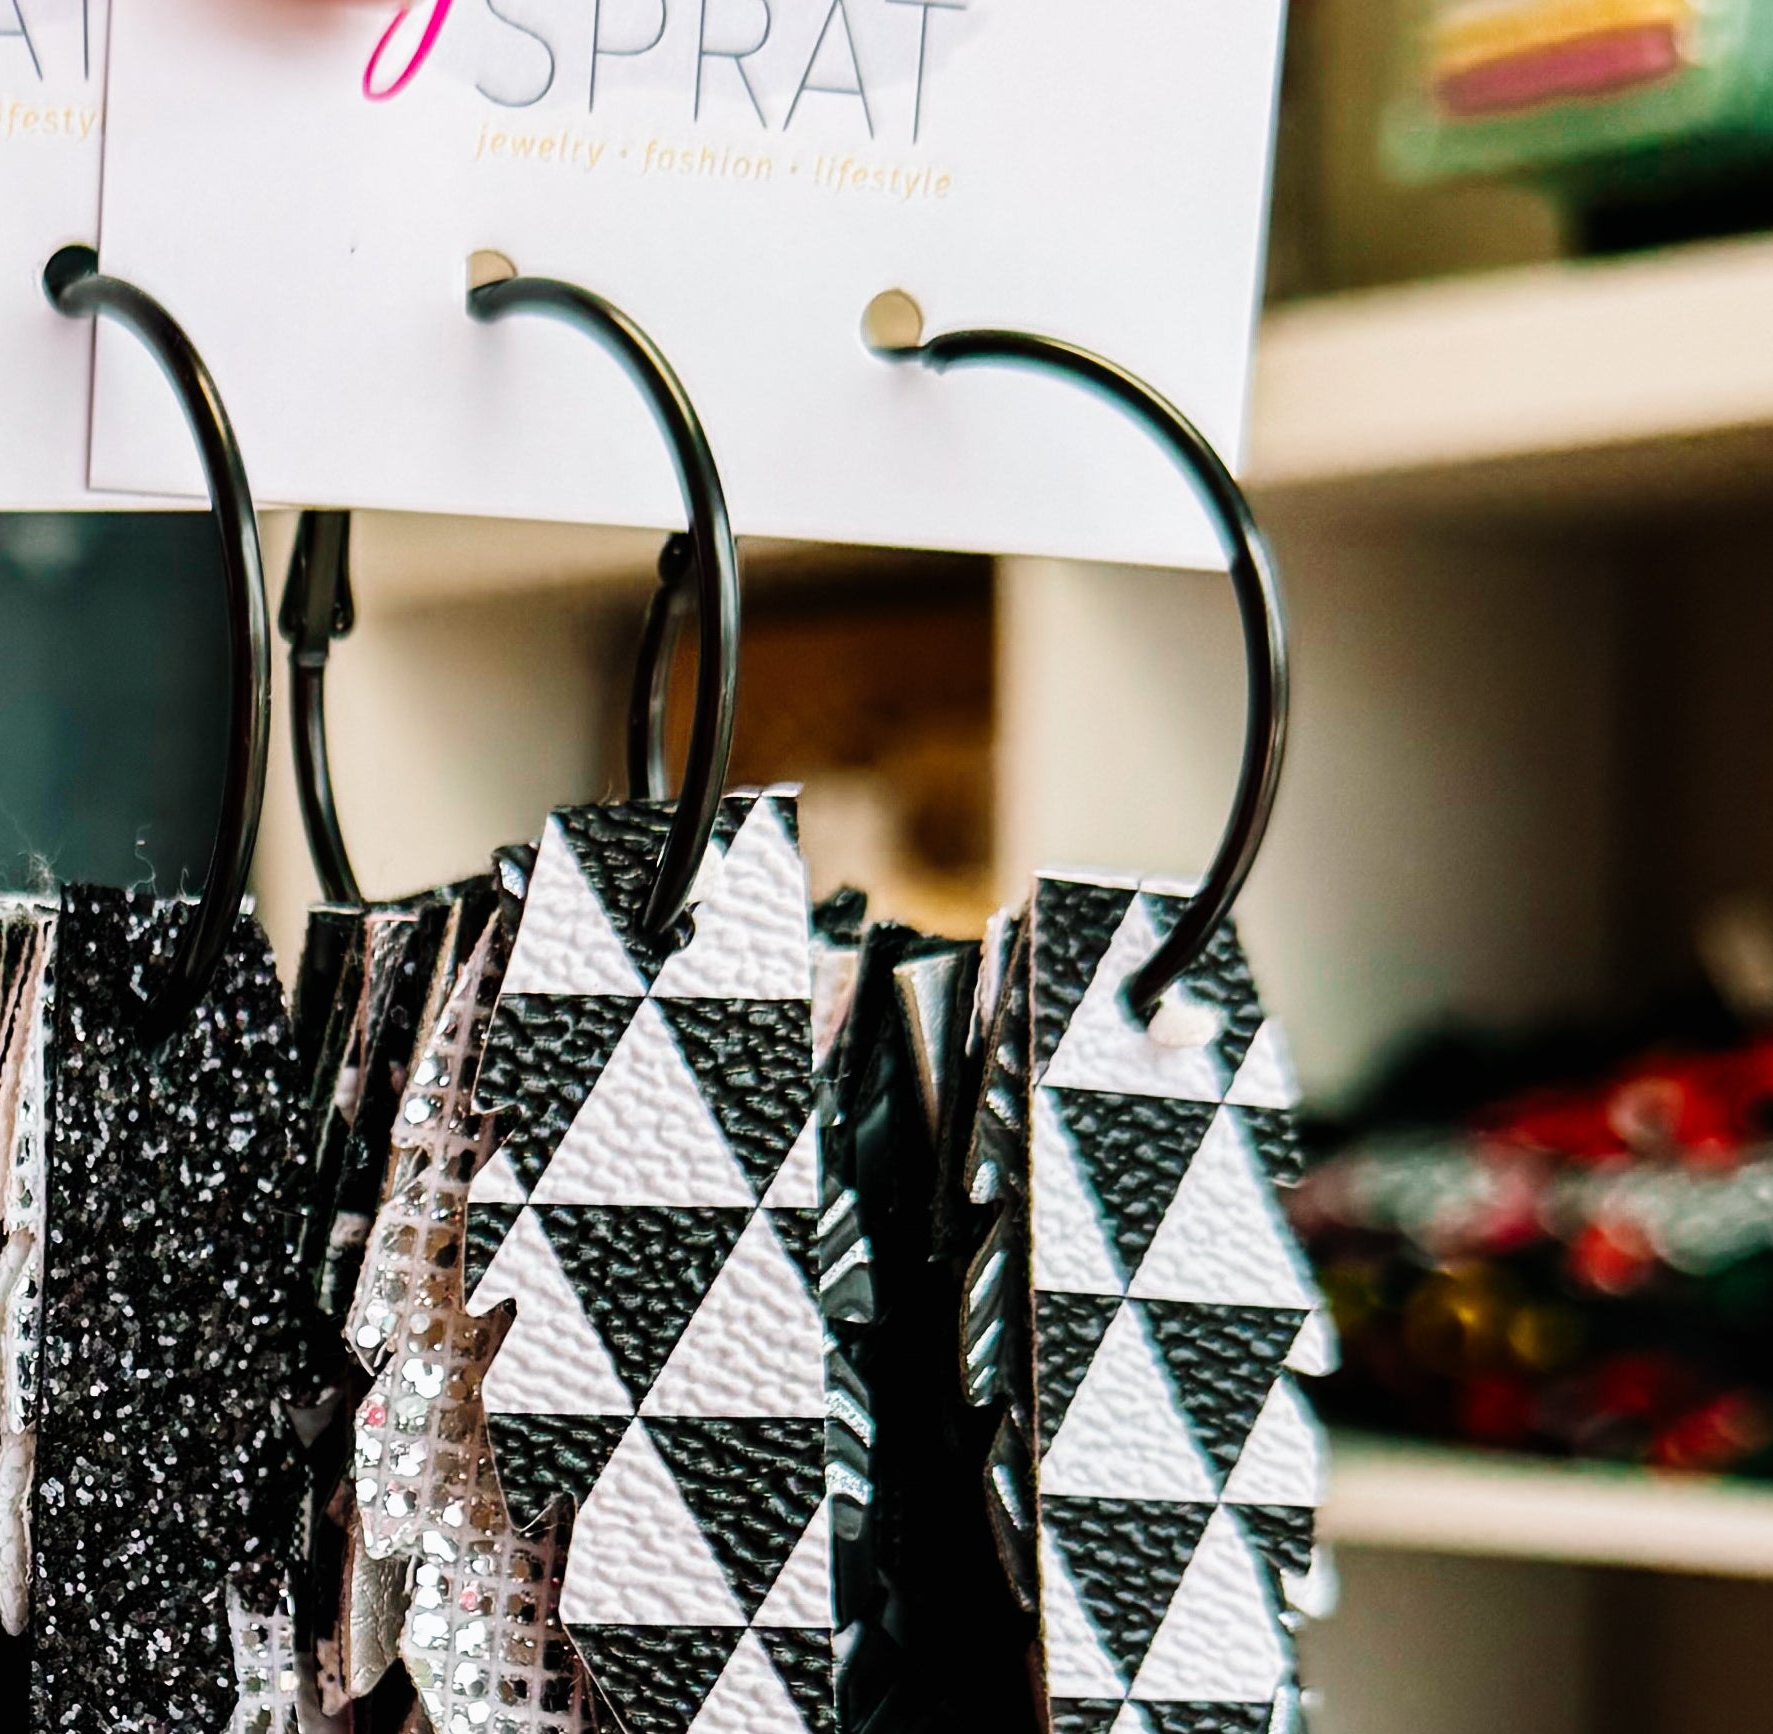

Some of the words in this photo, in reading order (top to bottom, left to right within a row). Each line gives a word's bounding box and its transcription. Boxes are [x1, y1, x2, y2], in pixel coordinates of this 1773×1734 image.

[474, 0, 968, 144] SPRAT
[475, 123, 604, 168] jewelry
[640, 137, 774, 181] fashion
[813, 156, 953, 200] lifestyle
